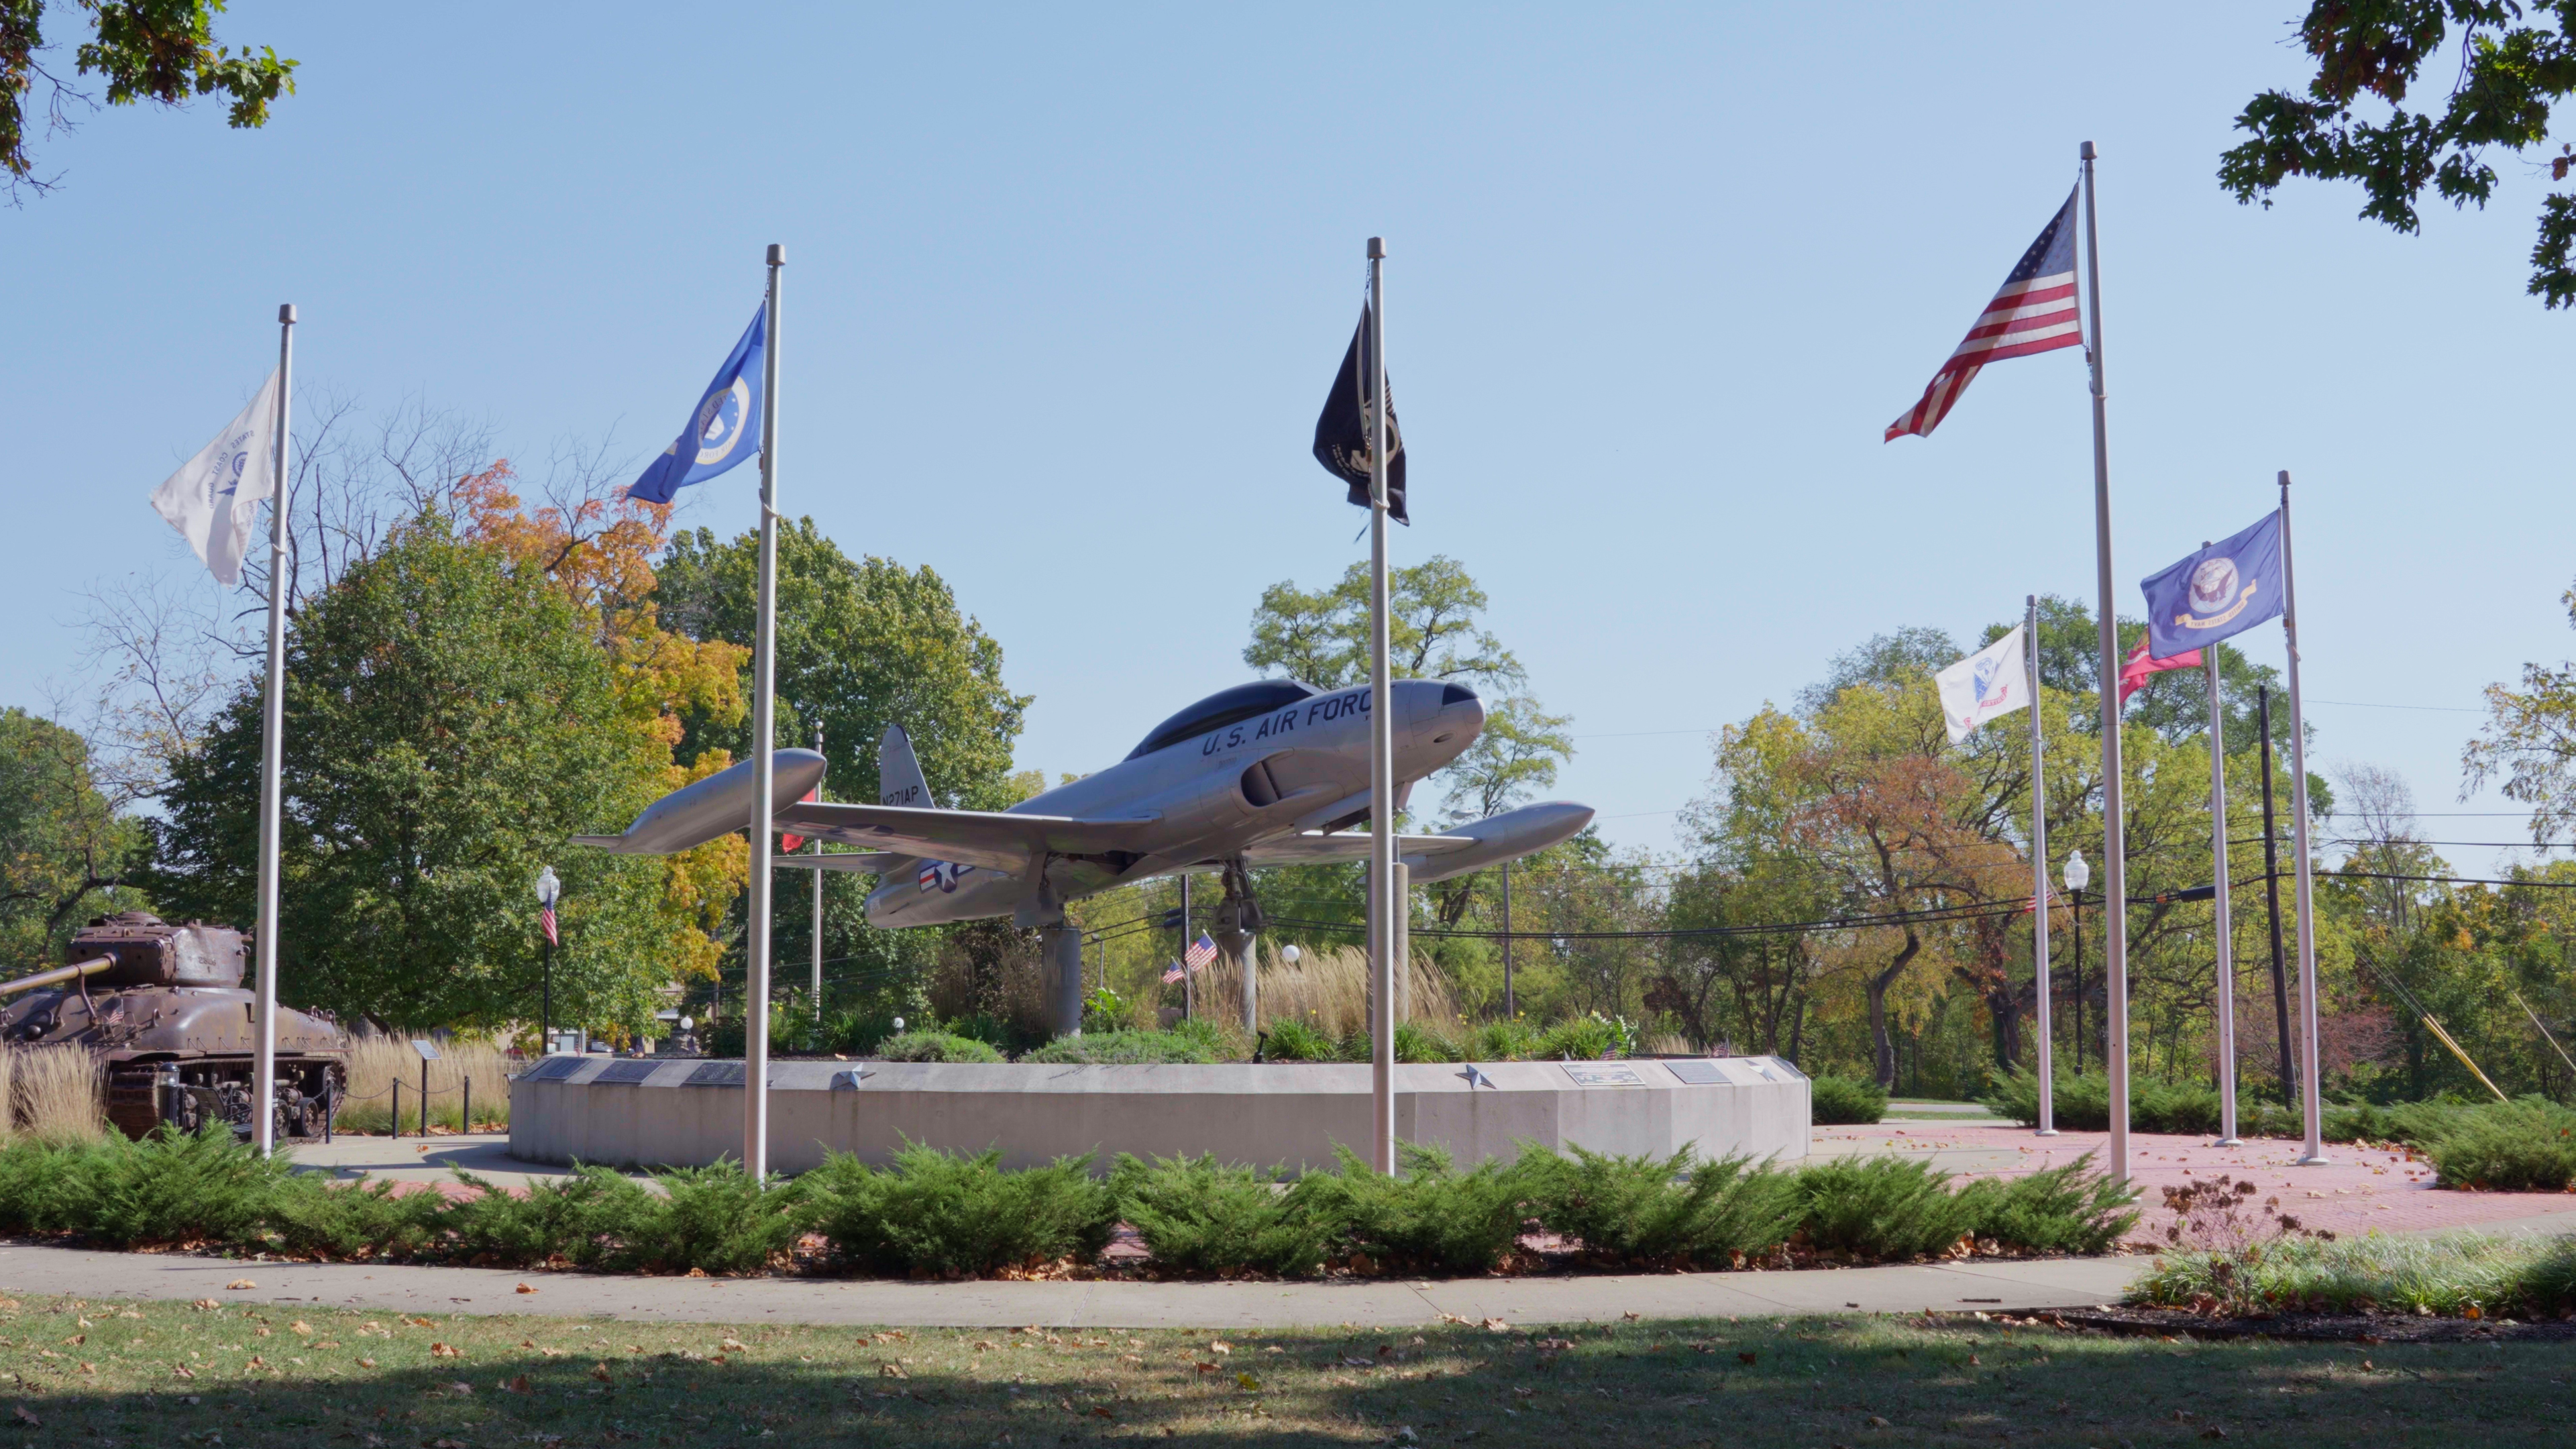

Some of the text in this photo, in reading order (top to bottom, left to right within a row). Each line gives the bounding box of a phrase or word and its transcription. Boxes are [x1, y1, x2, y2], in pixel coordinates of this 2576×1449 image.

[1202, 685, 1395, 756] U.S. AIR FORC
[882, 786, 918, 806] N271AP
